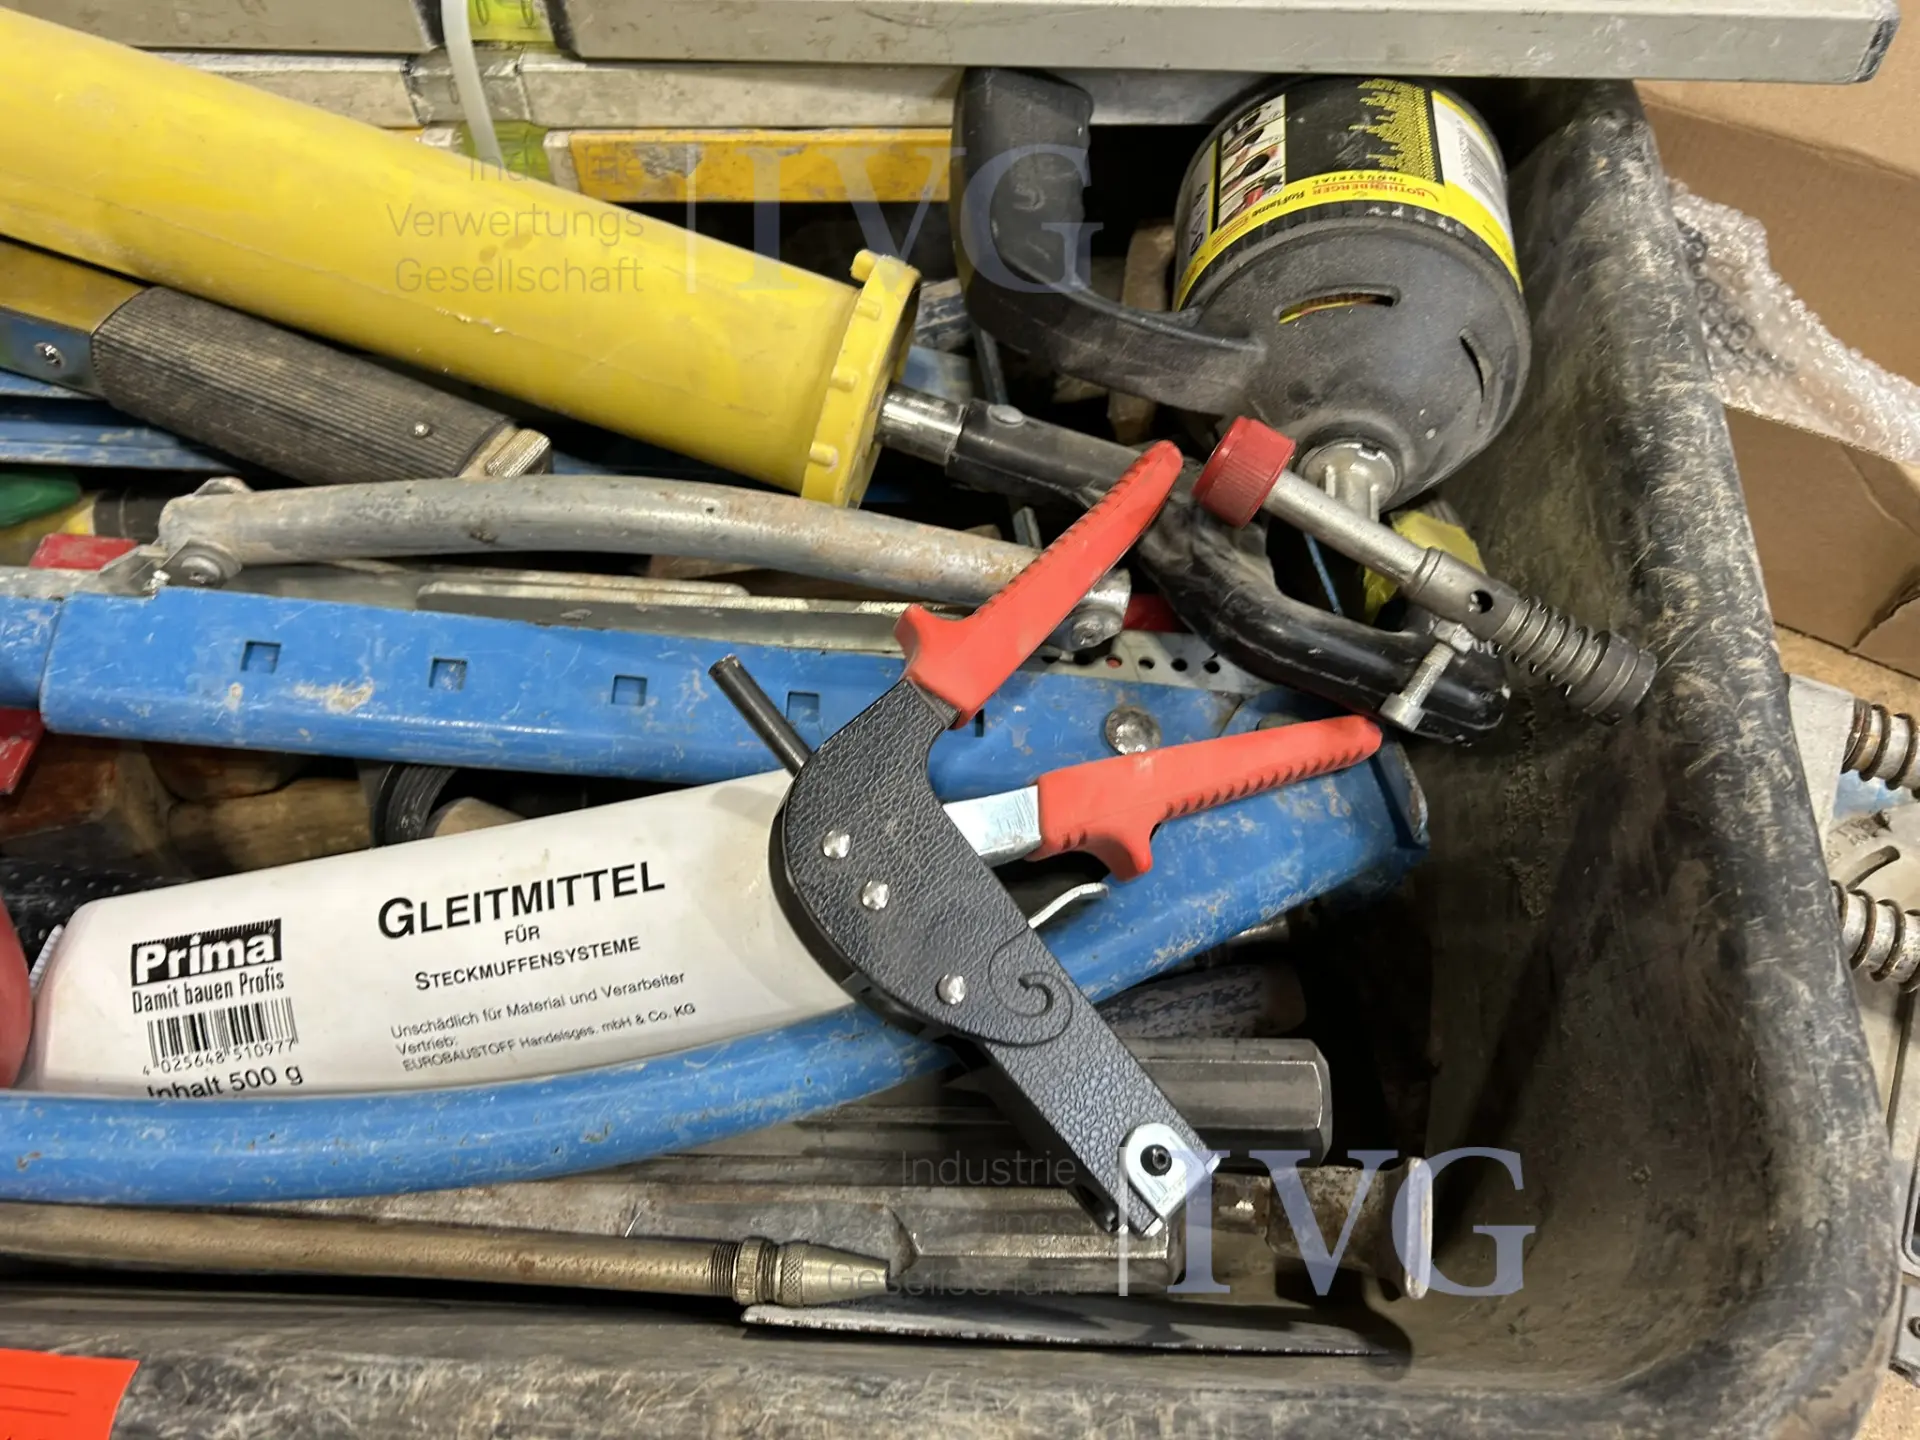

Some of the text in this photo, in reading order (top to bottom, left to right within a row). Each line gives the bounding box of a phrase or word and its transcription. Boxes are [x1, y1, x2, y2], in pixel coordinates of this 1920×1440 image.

[1252, 191, 1306, 218] RoFlame
[1312, 182, 1426, 197] ROTHENBERGER
[378, 861, 666, 940] GLEITMITTEL
[504, 925, 541, 945] FÜR
[136, 933, 275, 984] Prima
[414, 936, 641, 991] STECKMUFFENSYSTEME
[132, 966, 285, 1014] Damit bauen Profis
[390, 970, 686, 1039] Unschädlich für Material und Verarbeiter
[142, 1038, 295, 1076] 4 025648 510977
[395, 1034, 459, 1057] Vertrieb:
[402, 1002, 696, 1072] EUROBAUSTOFF Handelsges. mbH & Co. KG
[147, 1064, 304, 1099] Inhalt 500 g
